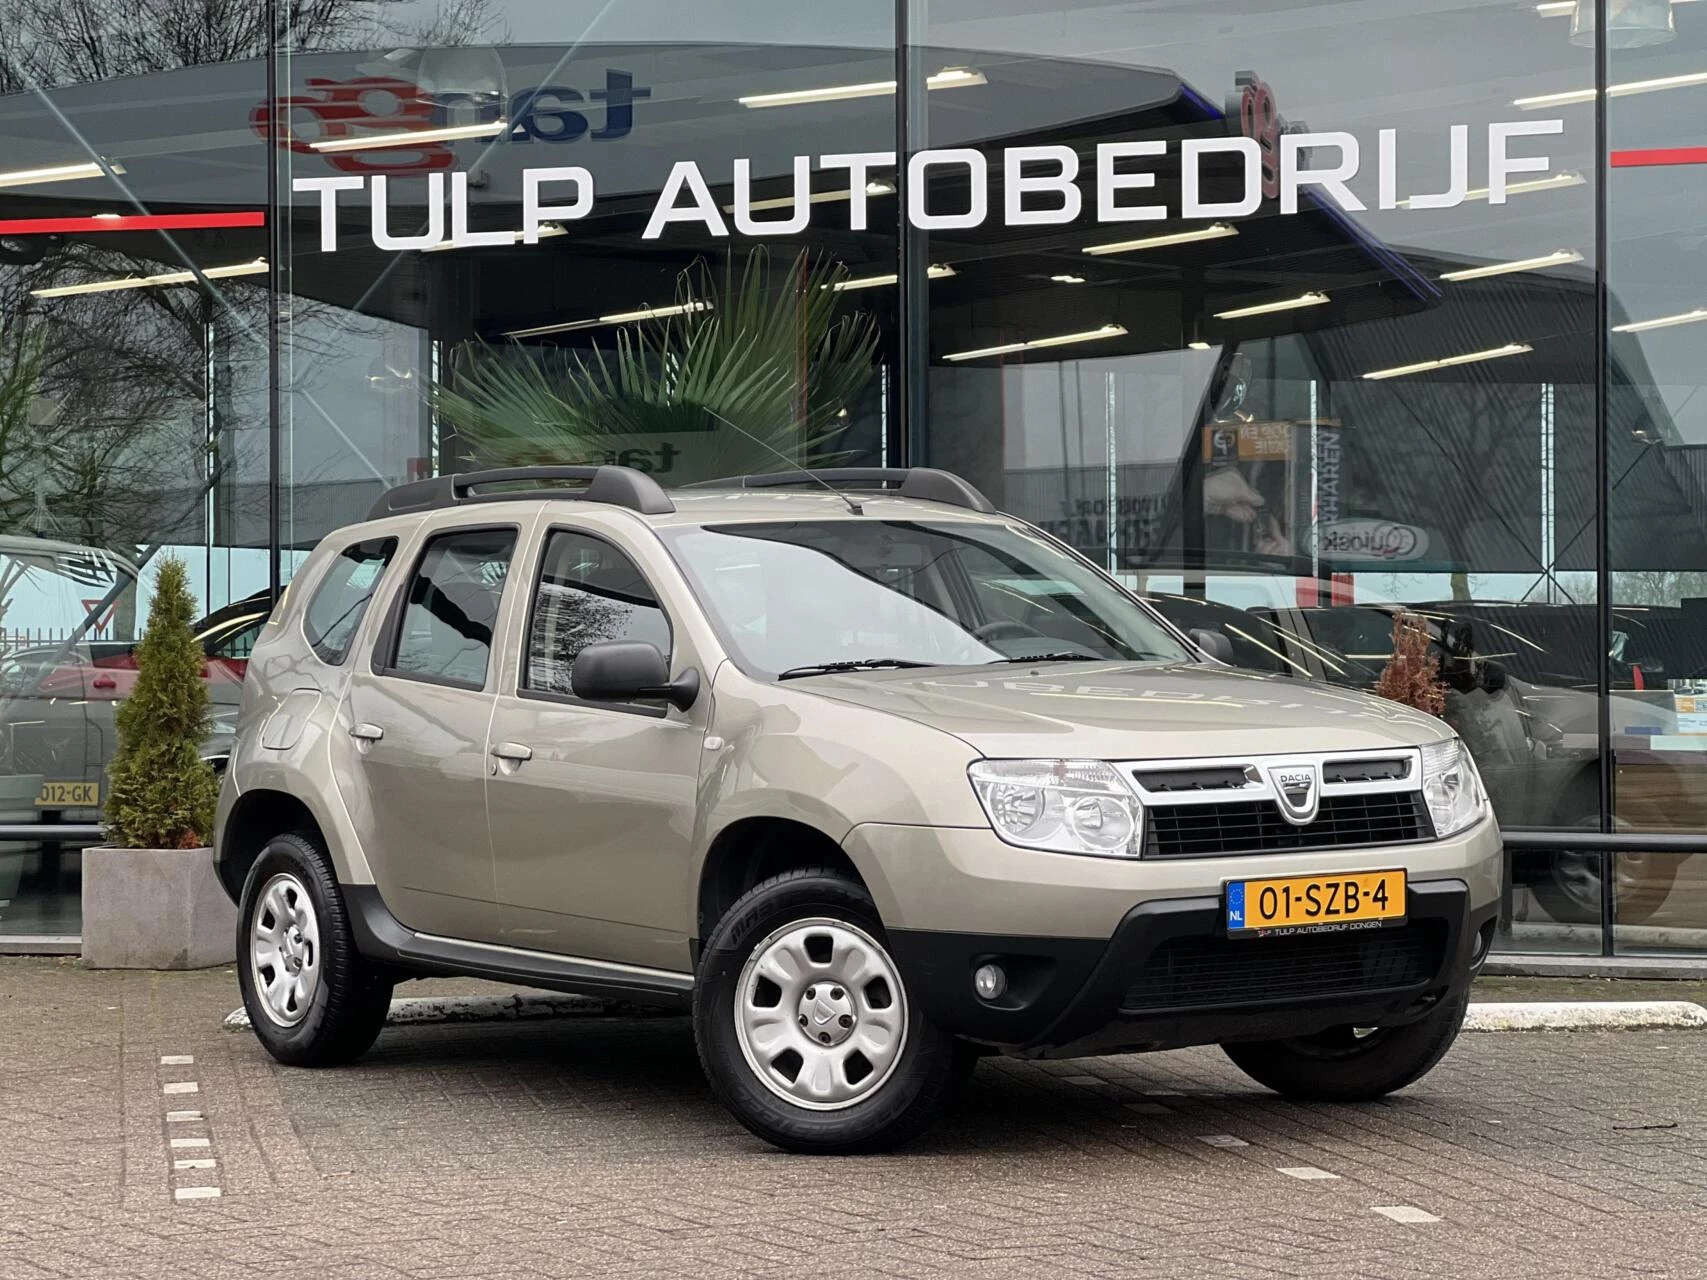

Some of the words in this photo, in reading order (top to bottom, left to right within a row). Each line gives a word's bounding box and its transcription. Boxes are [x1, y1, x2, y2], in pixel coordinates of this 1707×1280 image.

[292, 165, 594, 252] TULP
[641, 119, 1564, 240] AUTOBEDRIJF
[1280, 774, 1312, 782] DACIA
[1259, 879, 1389, 920] 01-SZB-4
[1230, 911, 1243, 921] NL
[1275, 927, 1295, 936] TULP
[1297, 923, 1348, 934] AUTOBEDRIJF
[1350, 921, 1382, 930] DONGEN
